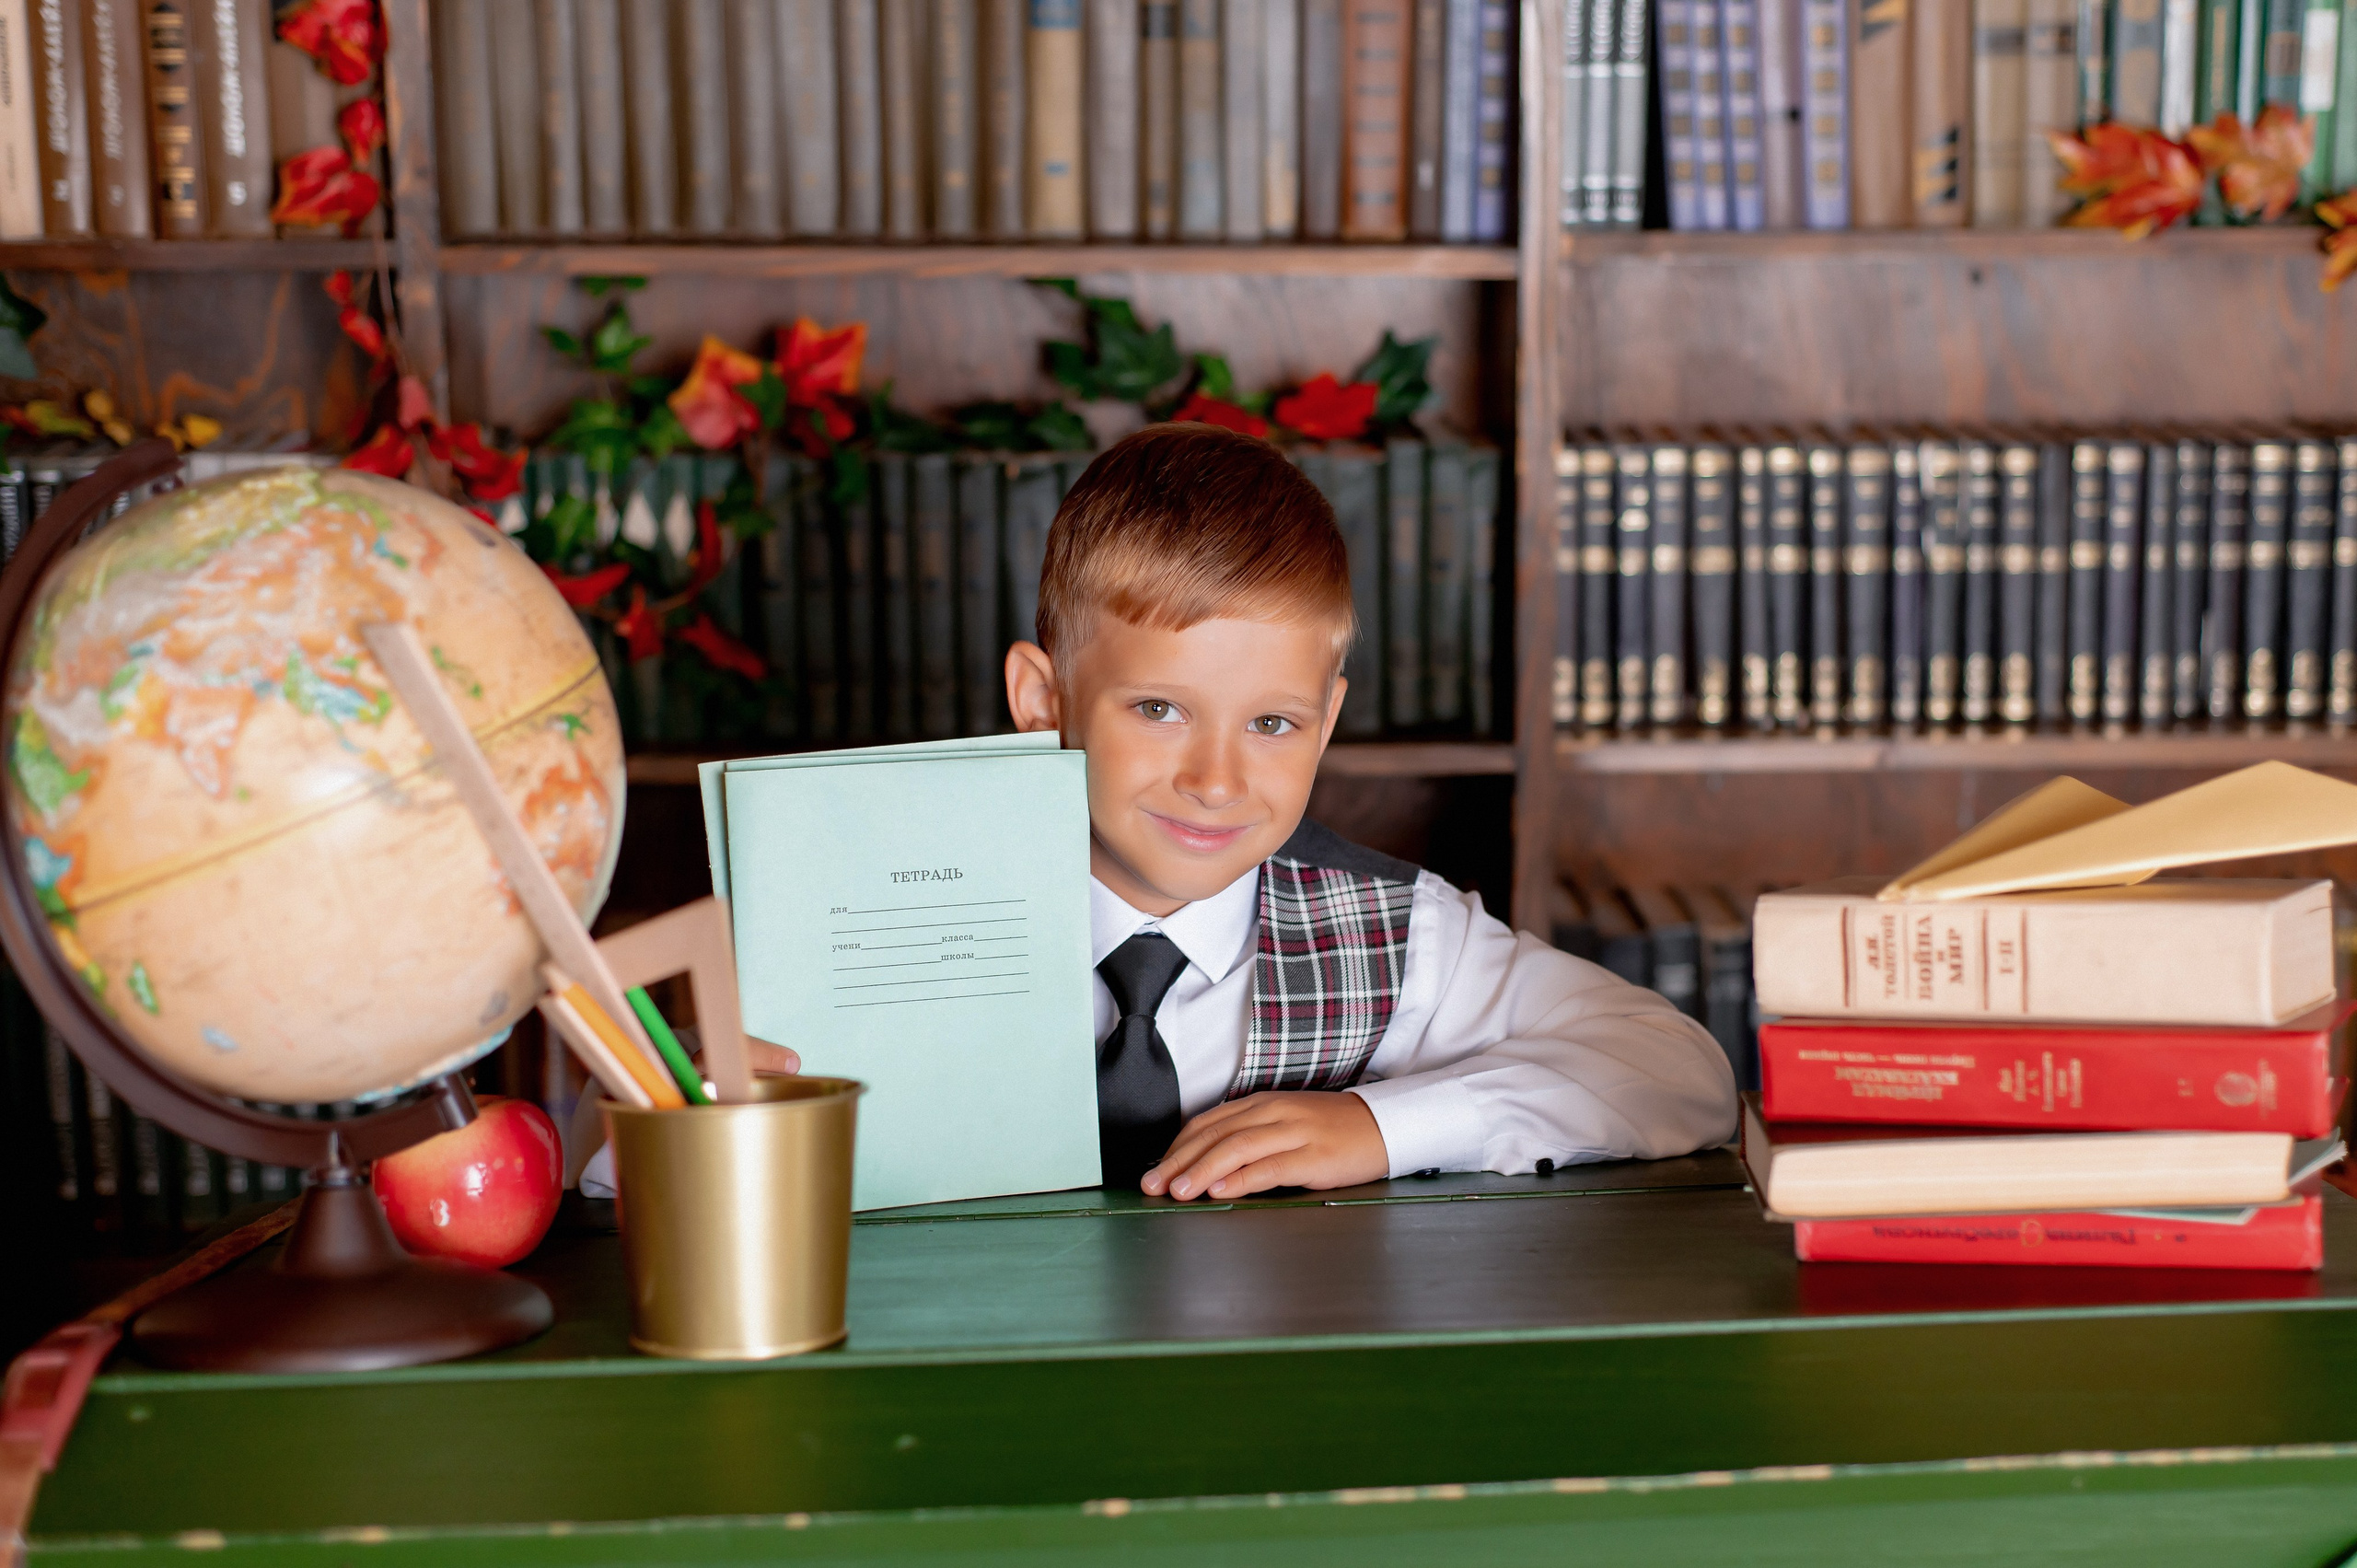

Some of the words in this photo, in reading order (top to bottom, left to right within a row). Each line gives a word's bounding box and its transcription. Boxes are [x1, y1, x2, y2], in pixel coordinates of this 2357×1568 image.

[890, 868, 963, 883] ТЕТРАДЬ
[830, 906, 848, 915] для
[831, 942, 861, 952] учени
[941, 934, 974, 943] класса
[941, 952, 974, 961] школы
[1913, 913, 1933, 1000] ВОЙНА
[1948, 928, 1963, 985] МИР
